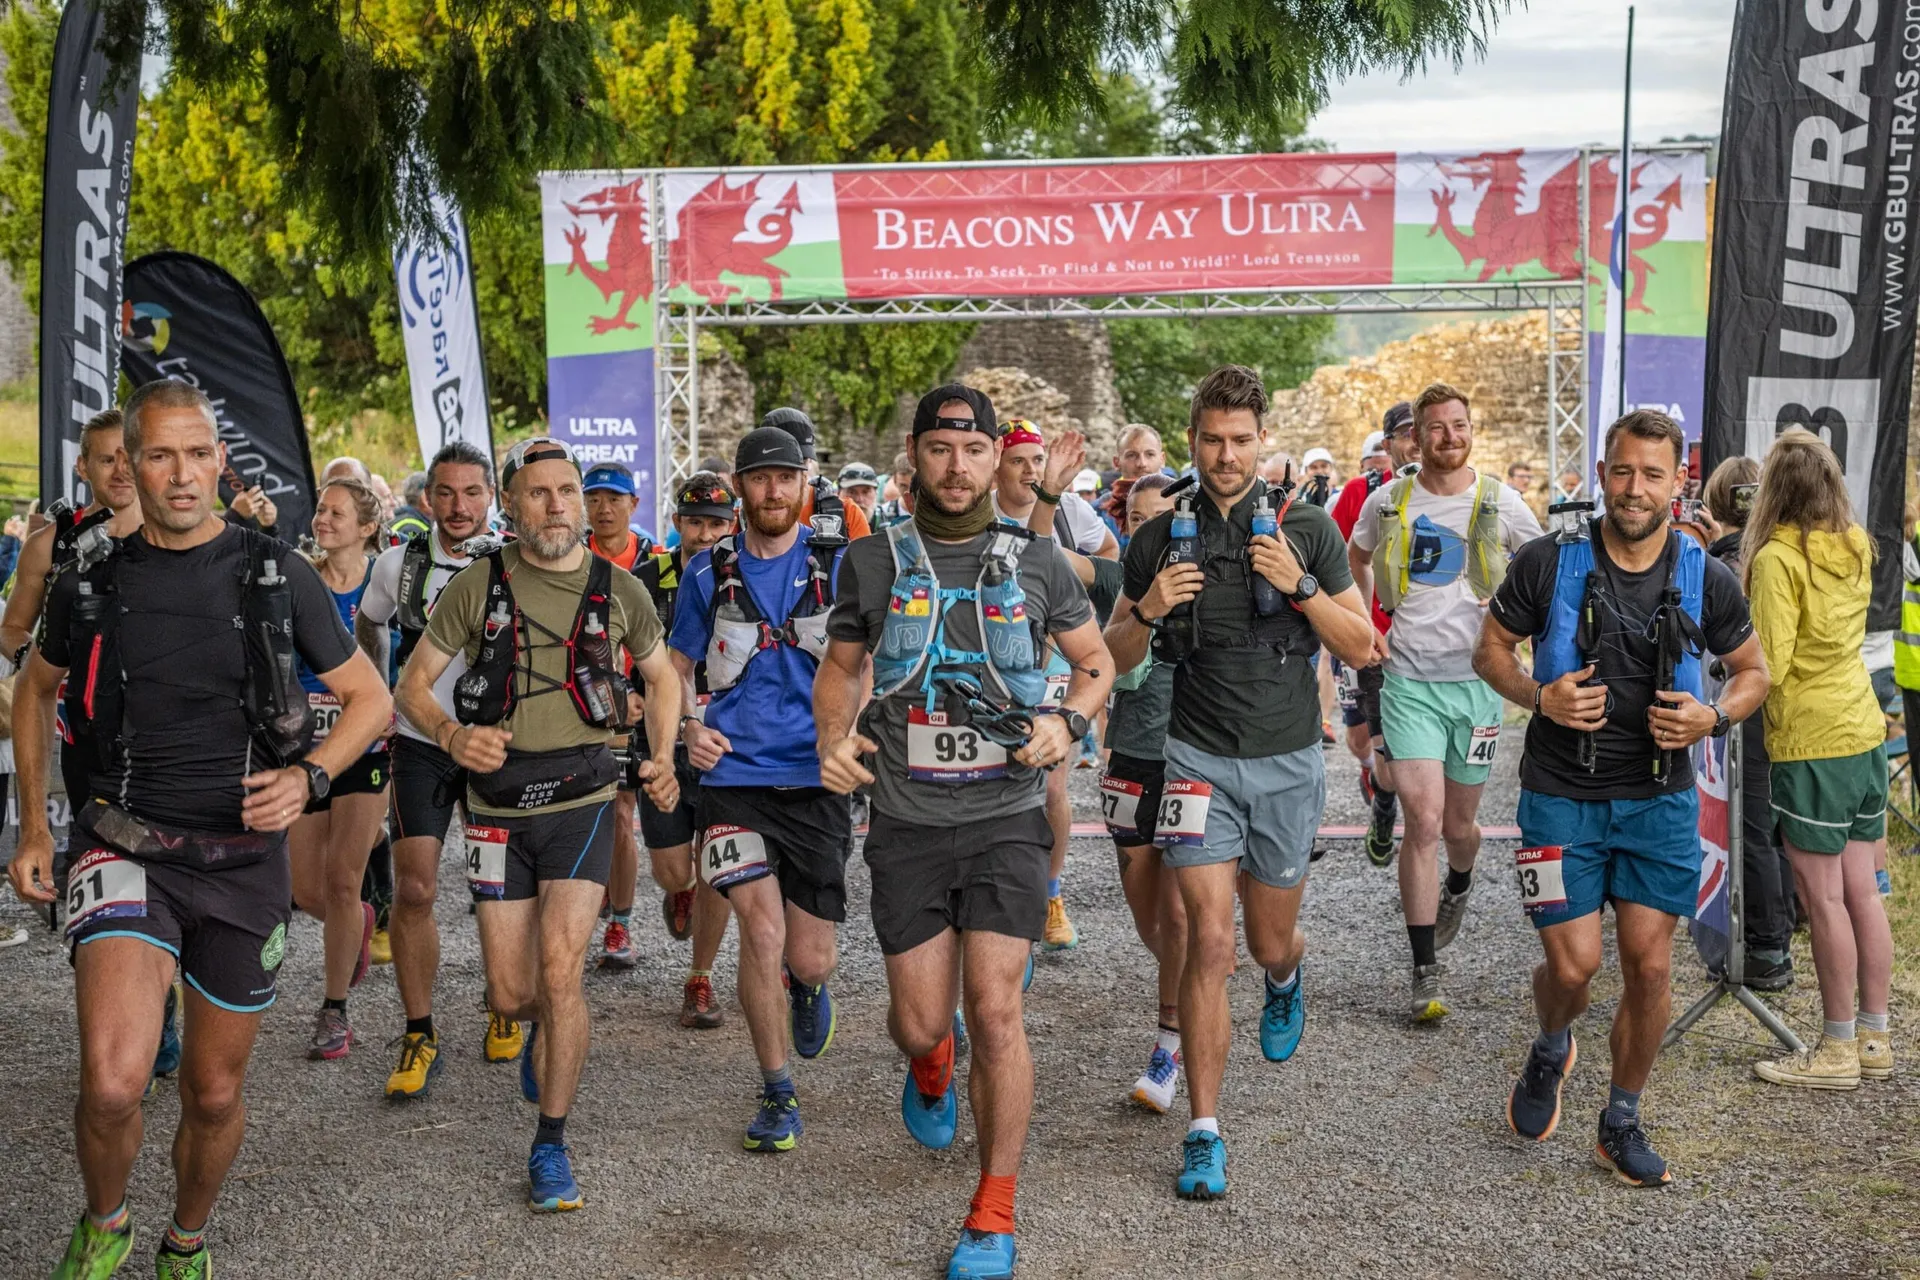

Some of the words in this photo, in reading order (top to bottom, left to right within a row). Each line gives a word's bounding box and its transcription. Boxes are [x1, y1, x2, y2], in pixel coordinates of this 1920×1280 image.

[71, 98, 114, 428] ULTRAS
[964, 266, 984, 278] To
[1038, 264, 1057, 276] To
[1064, 262, 1098, 274] Find
[1105, 261, 1117, 272] &
[1125, 260, 1152, 272] Not
[1159, 259, 1174, 270] to
[1244, 253, 1280, 267] Lord
[1286, 252, 1360, 267] Tennyson
[569, 418, 637, 436] ULTRA
[572, 444, 638, 462] GREAT
[930, 713, 945, 723] GB
[934, 731, 979, 763] 93
[1472, 739, 1496, 761] 40
[525, 780, 561, 793] COMP
[1104, 778, 1127, 790] ULTRAS
[517, 797, 551, 809] PORT
[521, 789, 554, 801] RESS
[1158, 798, 1183, 828] 43
[709, 825, 739, 837] ULTRAS
[709, 838, 741, 870] 44
[68, 868, 104, 915] 51
